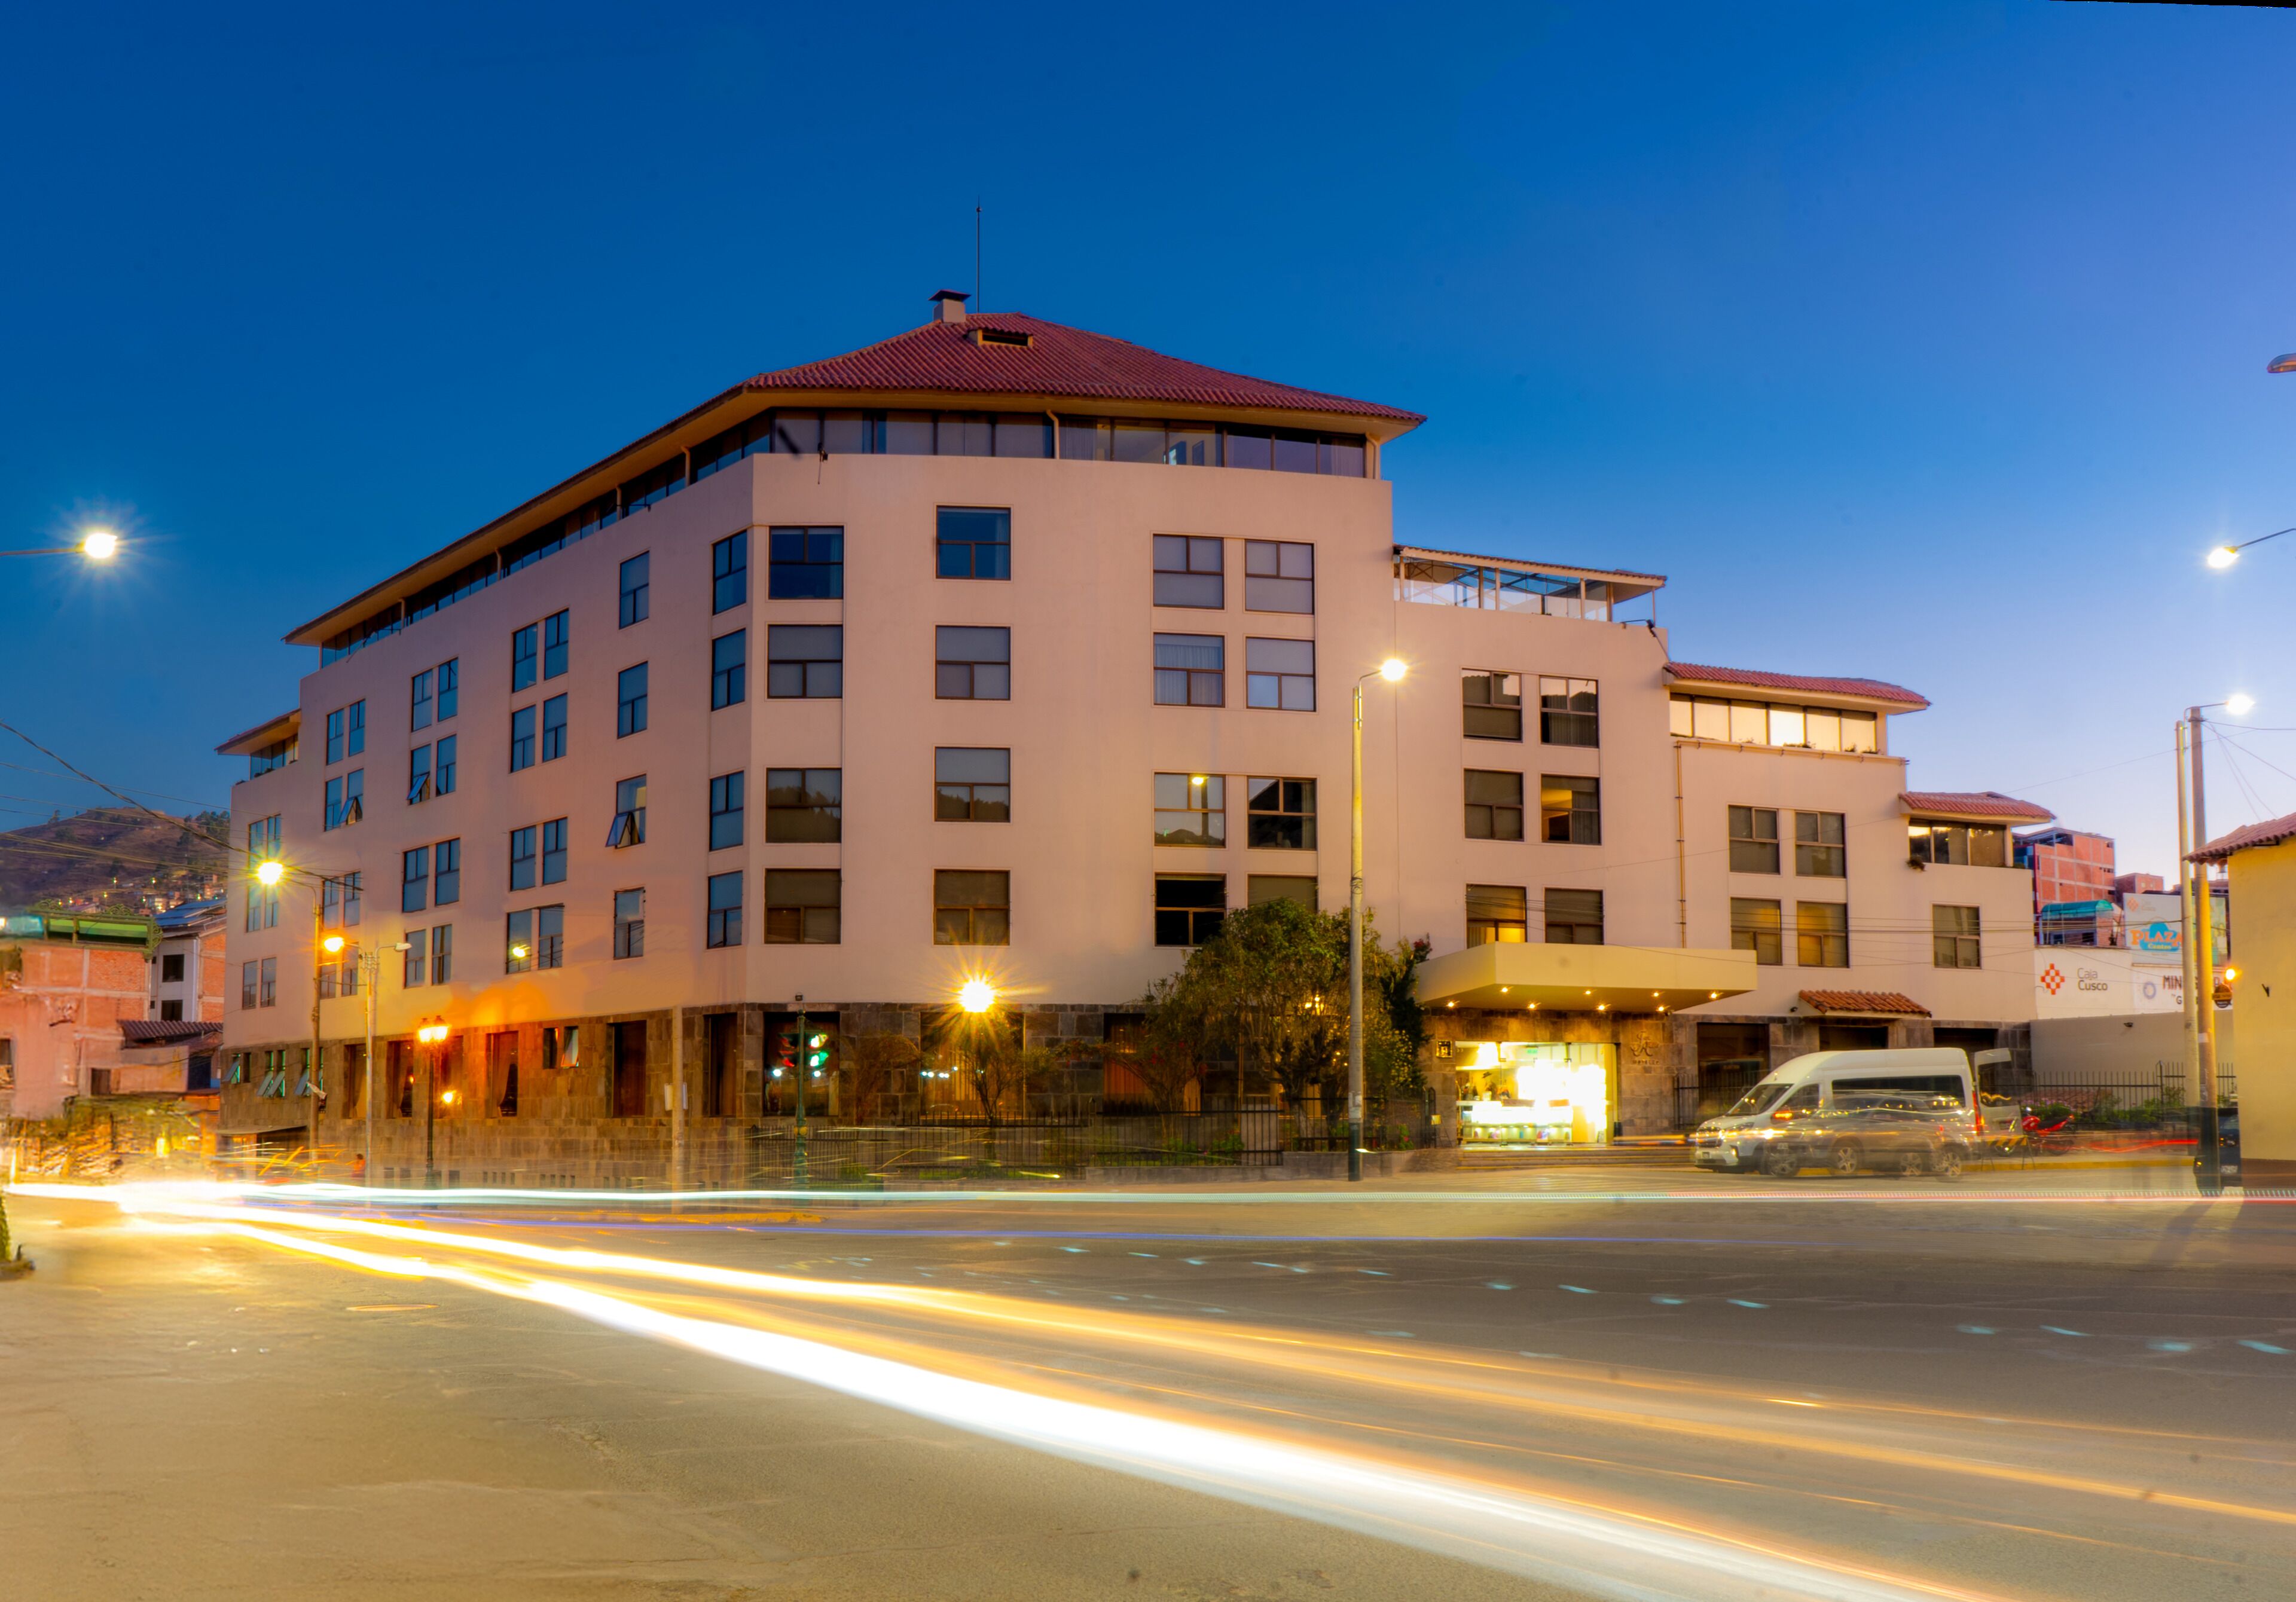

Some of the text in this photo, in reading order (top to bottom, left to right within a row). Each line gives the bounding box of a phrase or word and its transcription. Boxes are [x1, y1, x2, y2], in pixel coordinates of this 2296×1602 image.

[2077, 968, 2097, 980] Caja
[2078, 980, 2108, 990] Cusco
[2162, 975, 2182, 990] MIN
